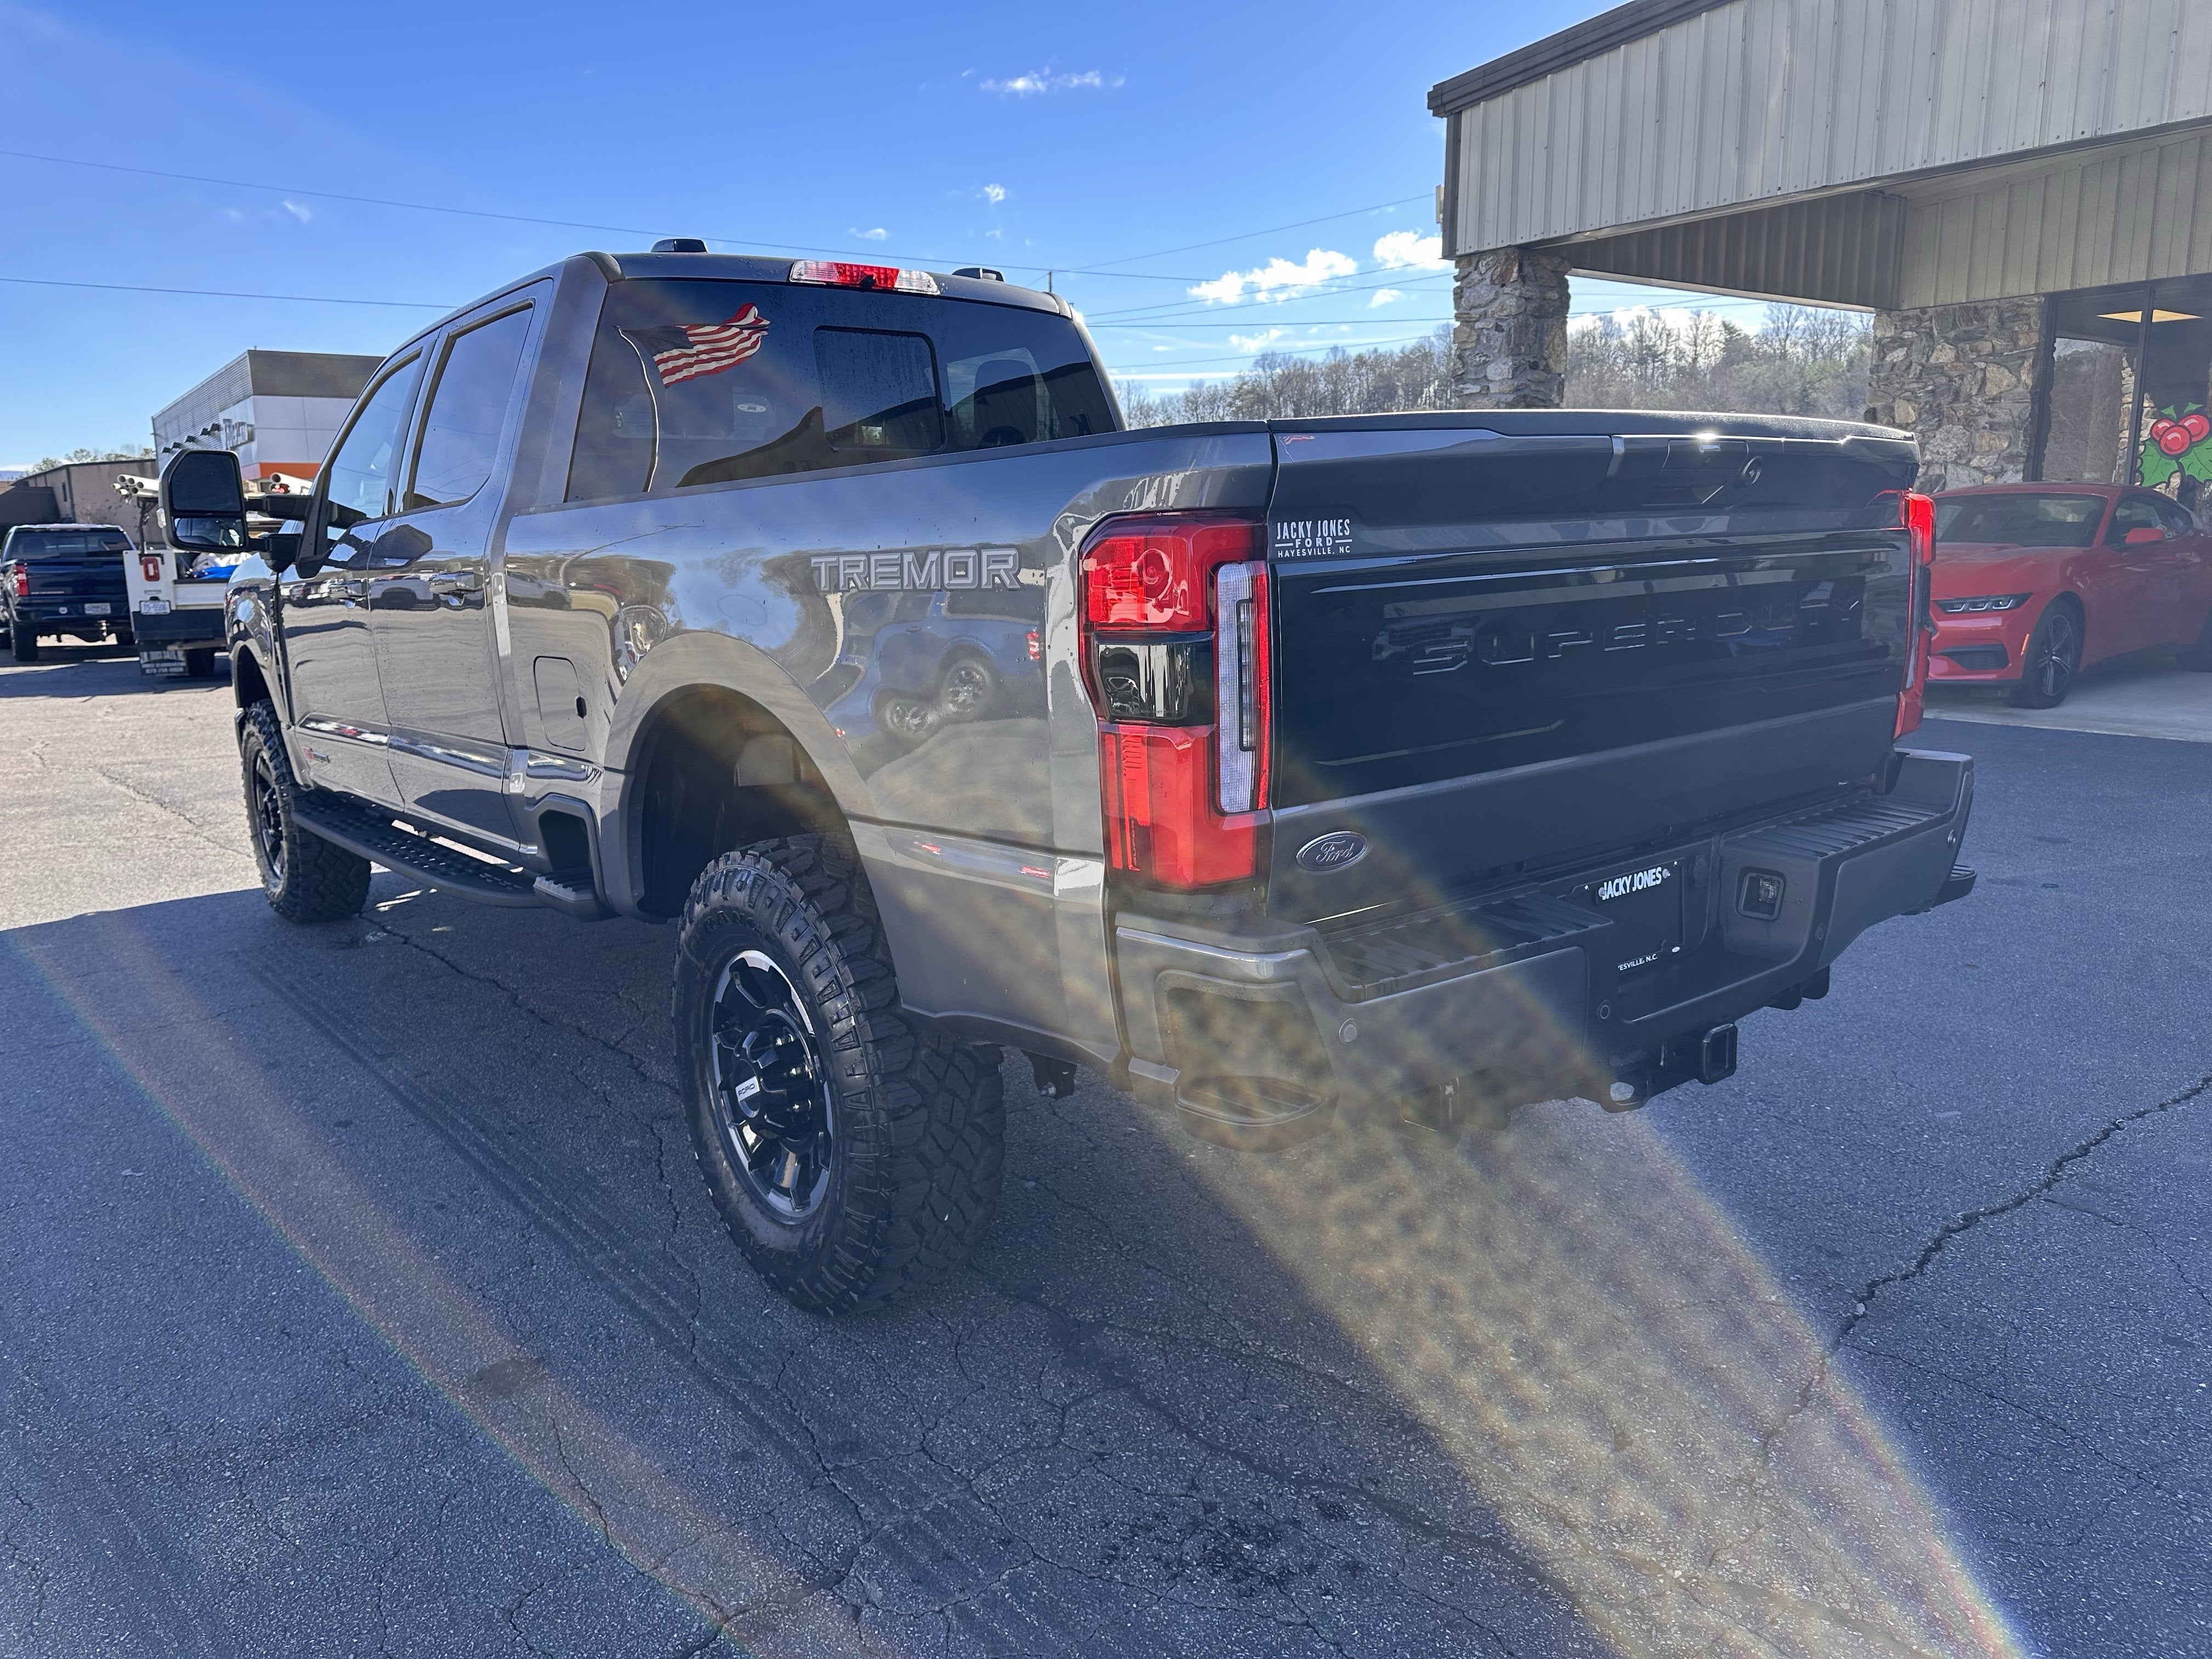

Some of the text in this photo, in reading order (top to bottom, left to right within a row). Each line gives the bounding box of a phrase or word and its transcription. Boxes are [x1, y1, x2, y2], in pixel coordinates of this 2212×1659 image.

[1277, 518, 1351, 540] JACKY JONES
[1278, 545, 1351, 558] HAYESVILLE, NC
[1295, 537, 1333, 548] FORD
[810, 548, 1022, 592] TREMOR
[1410, 612, 1698, 676] SUPER
[1316, 839, 1355, 864] Ford
[1602, 866, 1662, 900] JACKY JONES
[738, 1083, 755, 1096] FORD
